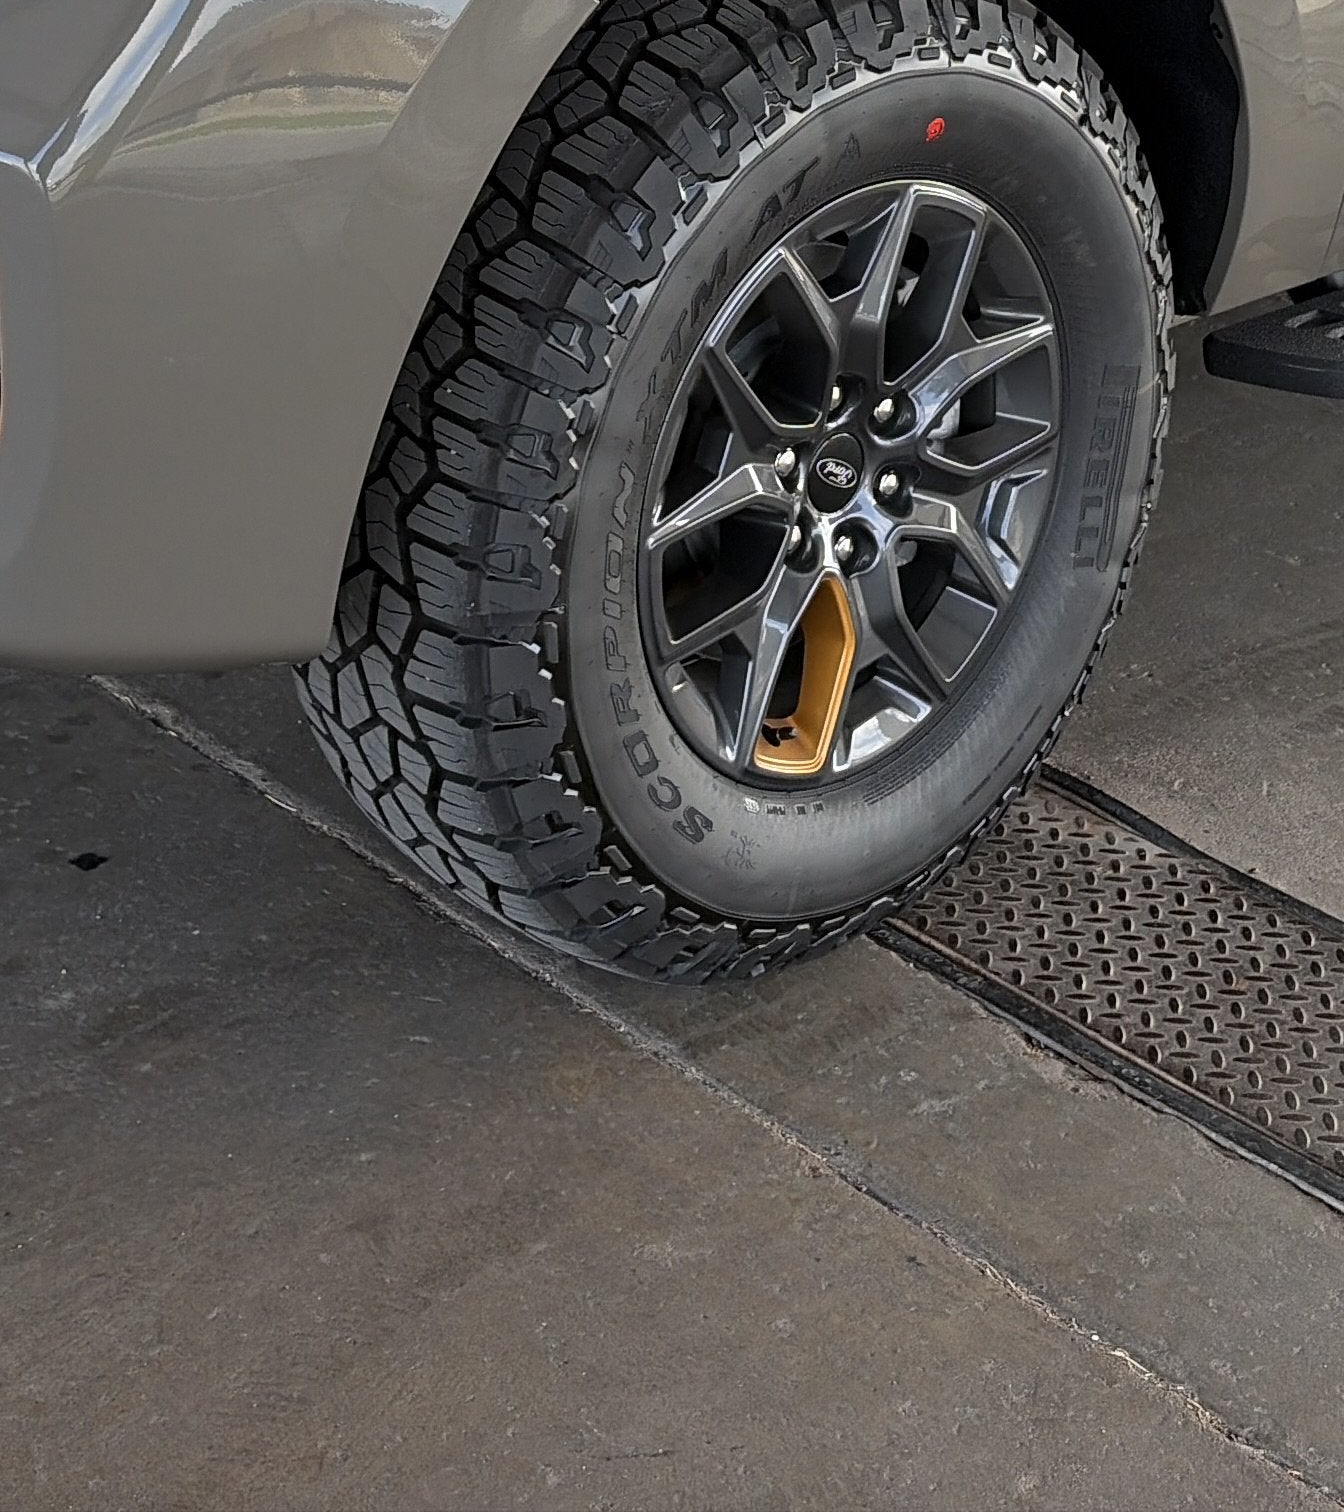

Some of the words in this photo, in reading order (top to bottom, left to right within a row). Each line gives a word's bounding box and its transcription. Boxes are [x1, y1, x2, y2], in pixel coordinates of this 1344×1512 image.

[822, 461, 854, 486] Ford
[1072, 364, 1142, 573] PIRELLI
[603, 460, 715, 846] SCORPION
